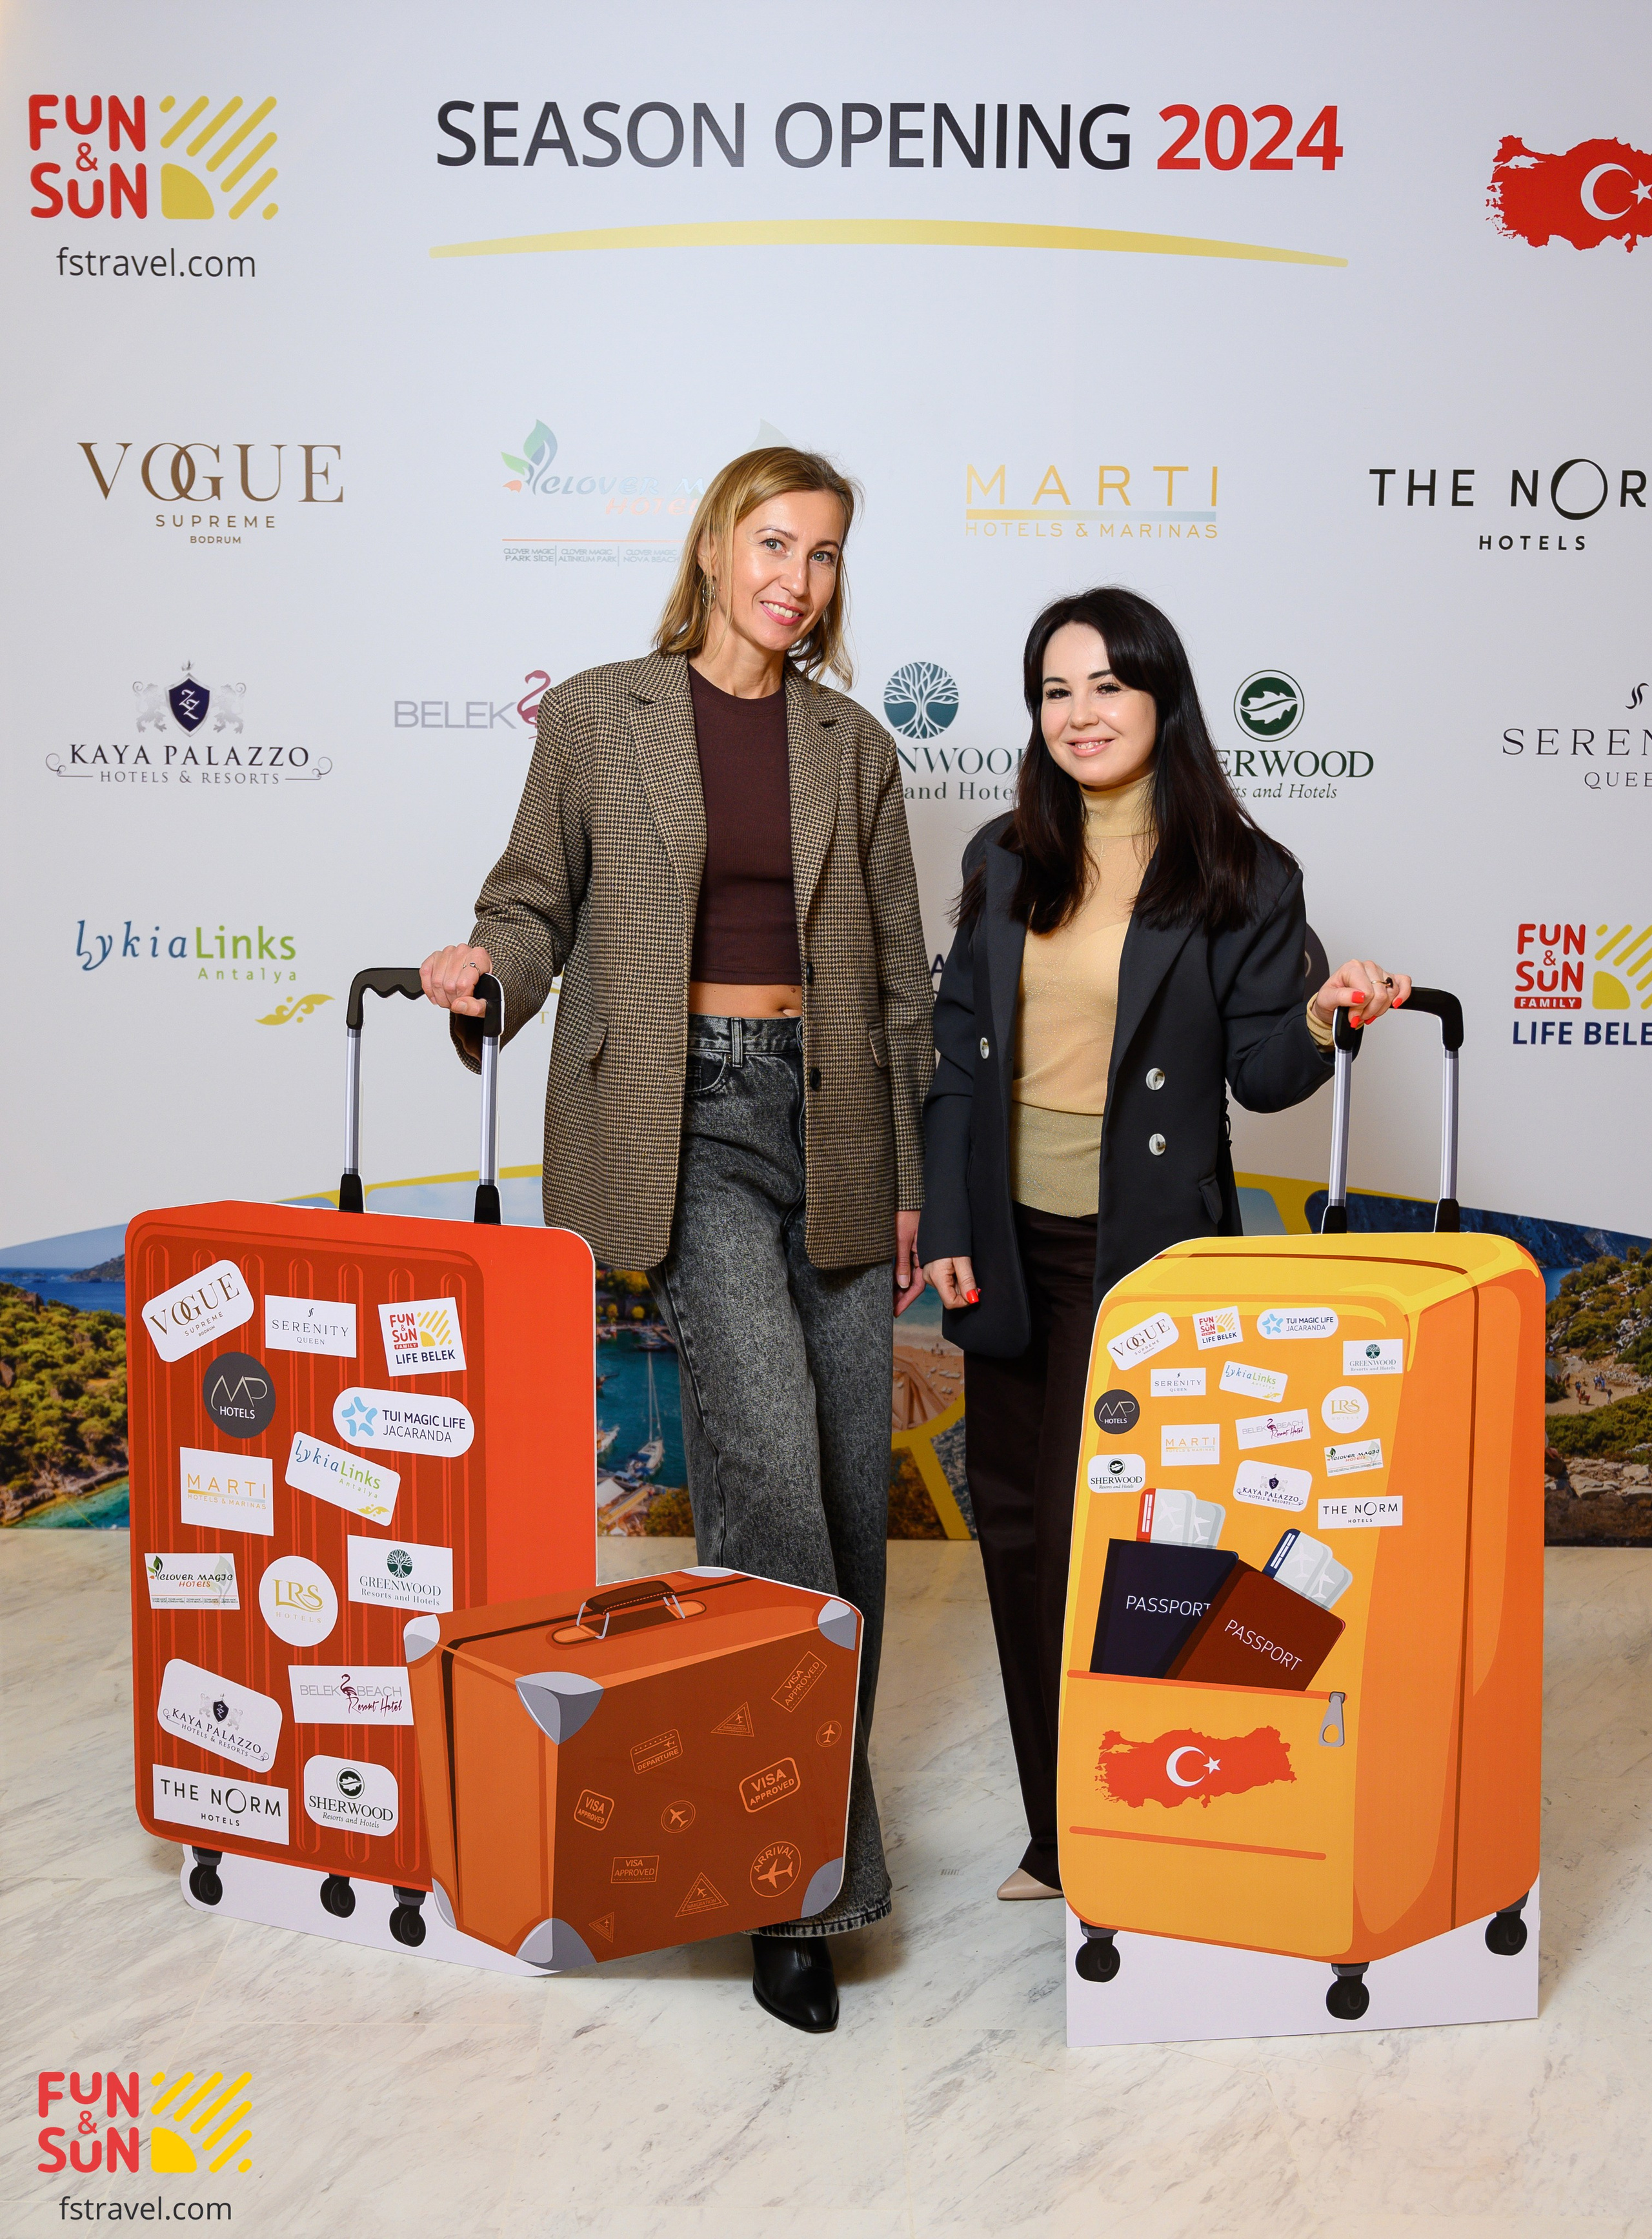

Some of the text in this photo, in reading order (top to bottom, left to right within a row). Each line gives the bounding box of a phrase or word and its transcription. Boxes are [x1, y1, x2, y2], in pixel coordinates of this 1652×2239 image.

[28, 94, 145, 151] FUN
[437, 100, 1344, 170] SEASON OPENING 2024
[76, 142, 97, 171] &
[30, 162, 146, 219] SUN
[56, 247, 255, 277] fstravel.com
[77, 442, 343, 503] VOGUE
[541, 476, 659, 494] CLOVER
[966, 464, 1218, 506] MARTI
[1369, 458, 1646, 520] THE NOR
[605, 498, 700, 515] HOTEL
[156, 514, 275, 528] SUPREME
[965, 522, 1218, 539] HOTELS & MARINAS
[190, 536, 241, 544] BODRUM
[1479, 535, 1585, 551] HOTELS
[394, 701, 517, 729] BELEK
[69, 744, 309, 766] KAYA PALAZZO
[100, 771, 279, 785] HOTELS & RESORTS
[1584, 772, 1652, 790] QUEE
[905, 782, 1013, 800] and Hote
[1253, 783, 1283, 798] and
[1288, 784, 1337, 798] Hotels
[1517, 924, 1586, 955] FUN
[1543, 950, 1556, 966] &
[198, 968, 296, 984] Antalya
[1515, 961, 1584, 992] SUN
[1520, 998, 1576, 1008] FAMILY
[1513, 1022, 1652, 1046] LIFE BELE
[150, 1273, 239, 1335] VOGUE
[185, 1312, 223, 1336] SUPREME
[272, 1319, 348, 1337] SERENITY
[390, 1313, 415, 1328] FUN
[1199, 1316, 1214, 1325] FUN
[1200, 1324, 1215, 1333] SUN
[199, 1326, 216, 1337] BODRUM
[392, 1328, 418, 1342] SUN
[1112, 1319, 1170, 1356] VOGUE
[1217, 1332, 1237, 1341] BELEK
[297, 1337, 325, 1345] QUEEN
[1134, 1339, 1160, 1355] SUPREME
[396, 1350, 456, 1364] LIFE BELEK
[211, 1375, 267, 1411] MP
[220, 1406, 256, 1419] HOTELS
[1099, 1401, 1135, 1422] MP
[1331, 1399, 1360, 1414] LRS
[383, 1410, 465, 1430] TUI MAGIC LIFE
[1242, 1420, 1303, 1435] BELEK BEACH
[383, 1424, 452, 1443] JACARANDA
[1166, 1437, 1215, 1446] MARTI
[188, 1474, 265, 1498] MARTI
[339, 1479, 378, 1499] Antalya
[1091, 1476, 1142, 1484] SHERWOOD
[188, 1494, 218, 1503] HOTELS
[229, 1500, 266, 1510] MARINAS
[1242, 1487, 1299, 1502] KAYA PALAZZO
[1323, 1502, 1398, 1515] THE NORM
[360, 1575, 441, 1597] GREENWOOD
[272, 1579, 323, 1612] LRS
[361, 1588, 392, 1599] Resorts
[414, 1596, 440, 1606] Hotels
[1126, 1595, 1211, 1617] PASSPORT
[276, 1612, 321, 1623] HOTELS
[1224, 1619, 1303, 1670] PASSPORT
[784, 1670, 804, 1690] VISA
[785, 1662, 820, 1706] APPROVED
[300, 1685, 402, 1697] BELEK BEACH
[345, 1696, 402, 1717] Resort Hotel
[172, 1708, 261, 1754] KAYA PALAZZO
[181, 1724, 207, 1739] HOTELS
[219, 1739, 248, 1757] RESORTS
[638, 1748, 679, 1770] DEPARTURE
[751, 1768, 787, 1792] VISA
[161, 1779, 281, 1817] THE NORM
[750, 1778, 794, 1806] APPROVED
[309, 1796, 393, 1821] SHERWOOD
[585, 1797, 605, 1814] VISA
[201, 1813, 240, 1827] HOTELS
[323, 1812, 343, 1822] Resorts
[360, 1819, 379, 1829] Hotels
[578, 1808, 605, 1825] APPROVED
[754, 1846, 794, 1872] ARRIVAL
[614, 1868, 654, 1876] APPROVED
